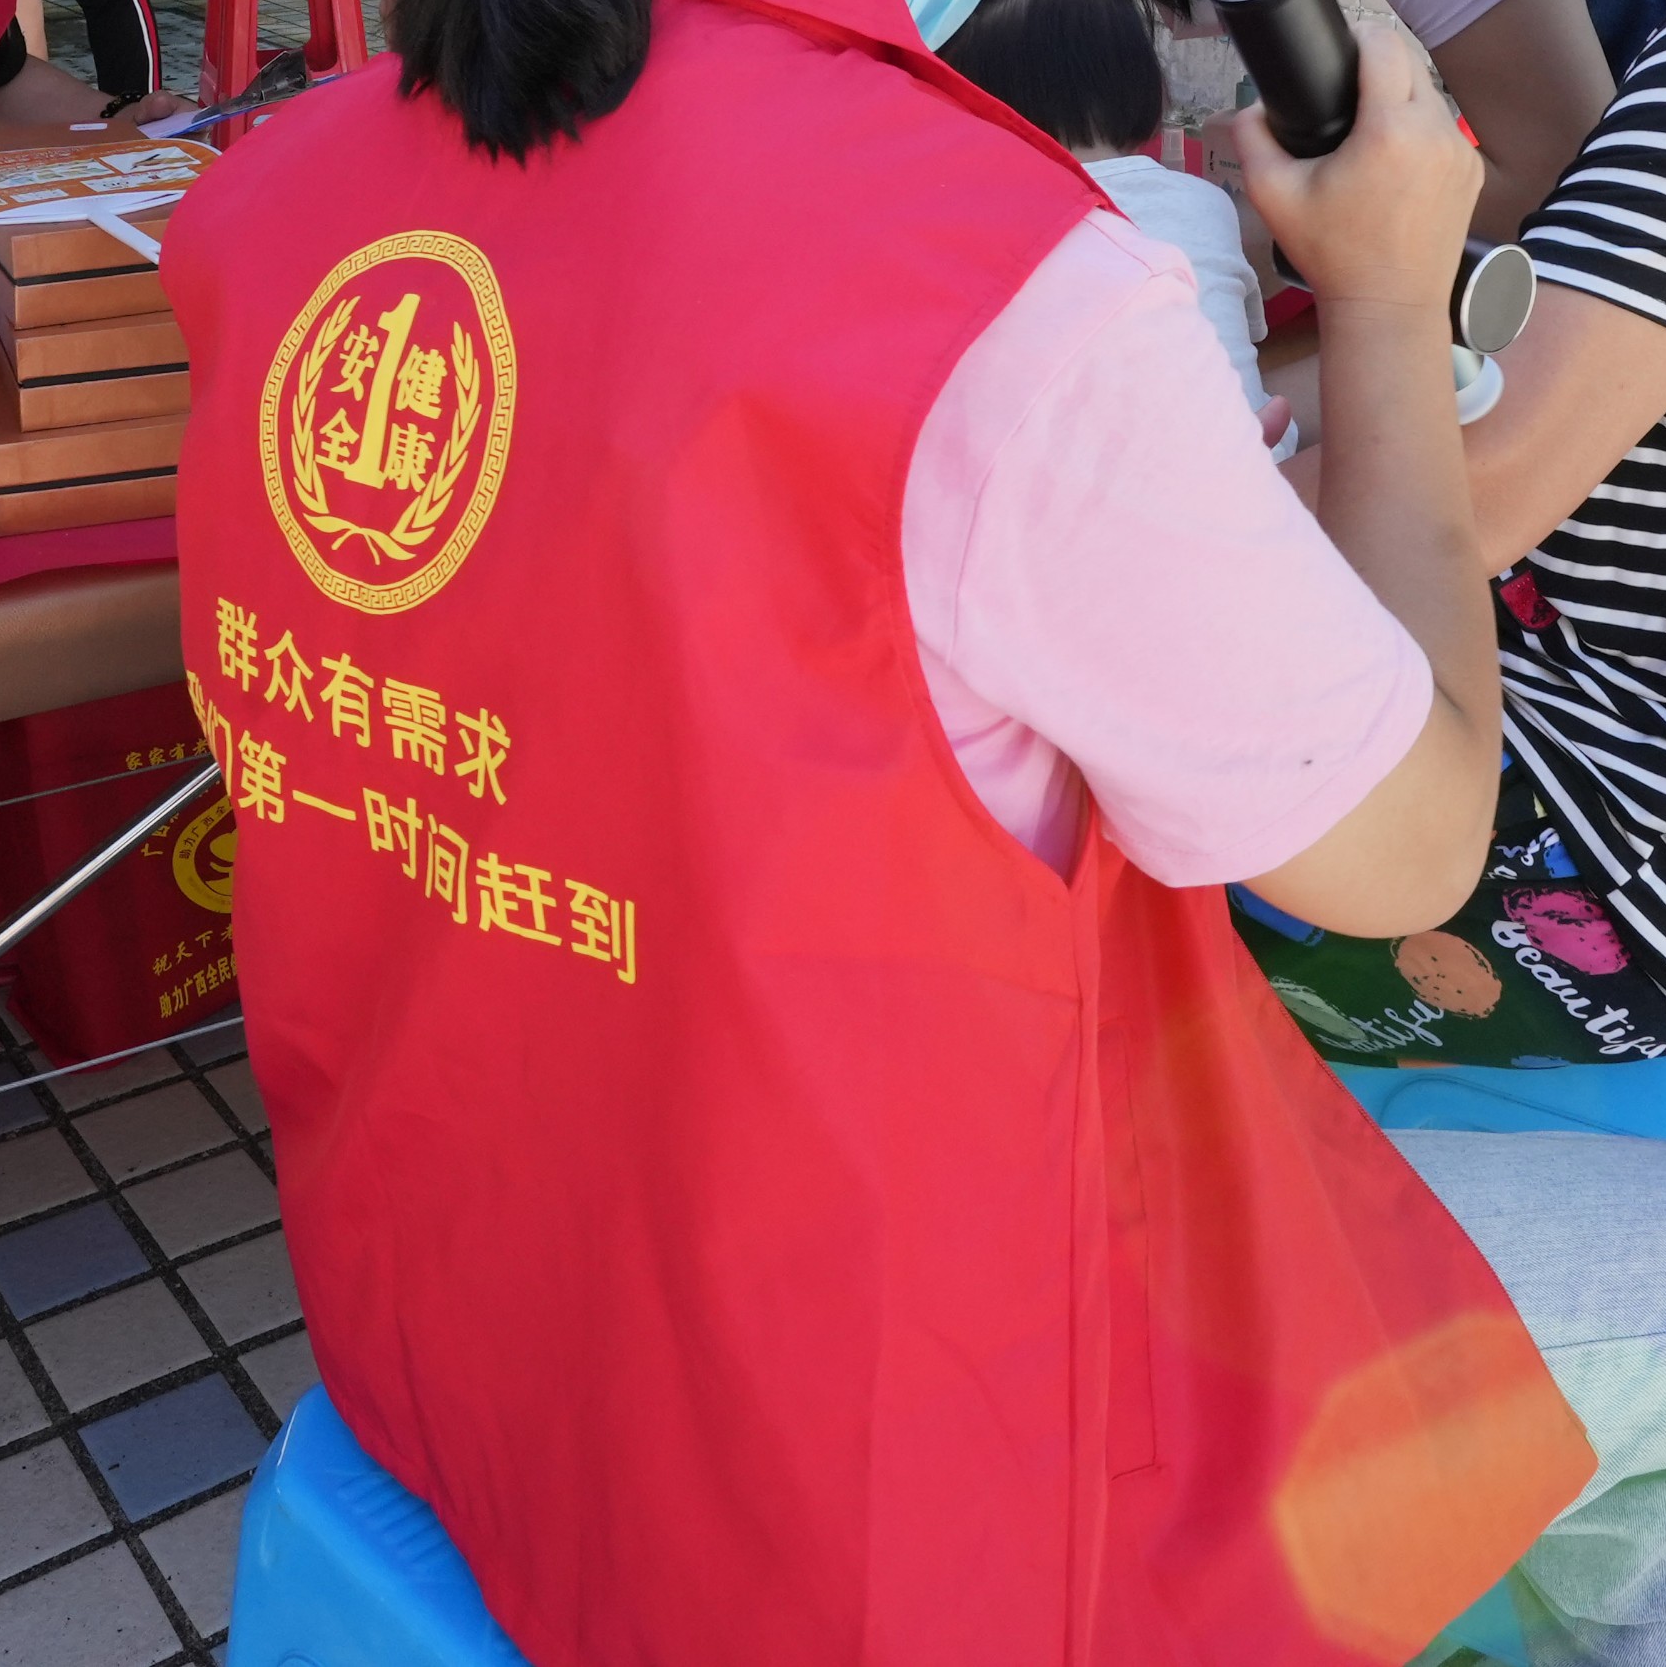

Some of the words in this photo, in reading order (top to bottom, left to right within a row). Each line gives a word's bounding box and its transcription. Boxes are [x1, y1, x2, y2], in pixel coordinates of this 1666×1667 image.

[215, 595, 513, 806] 群众有需求
